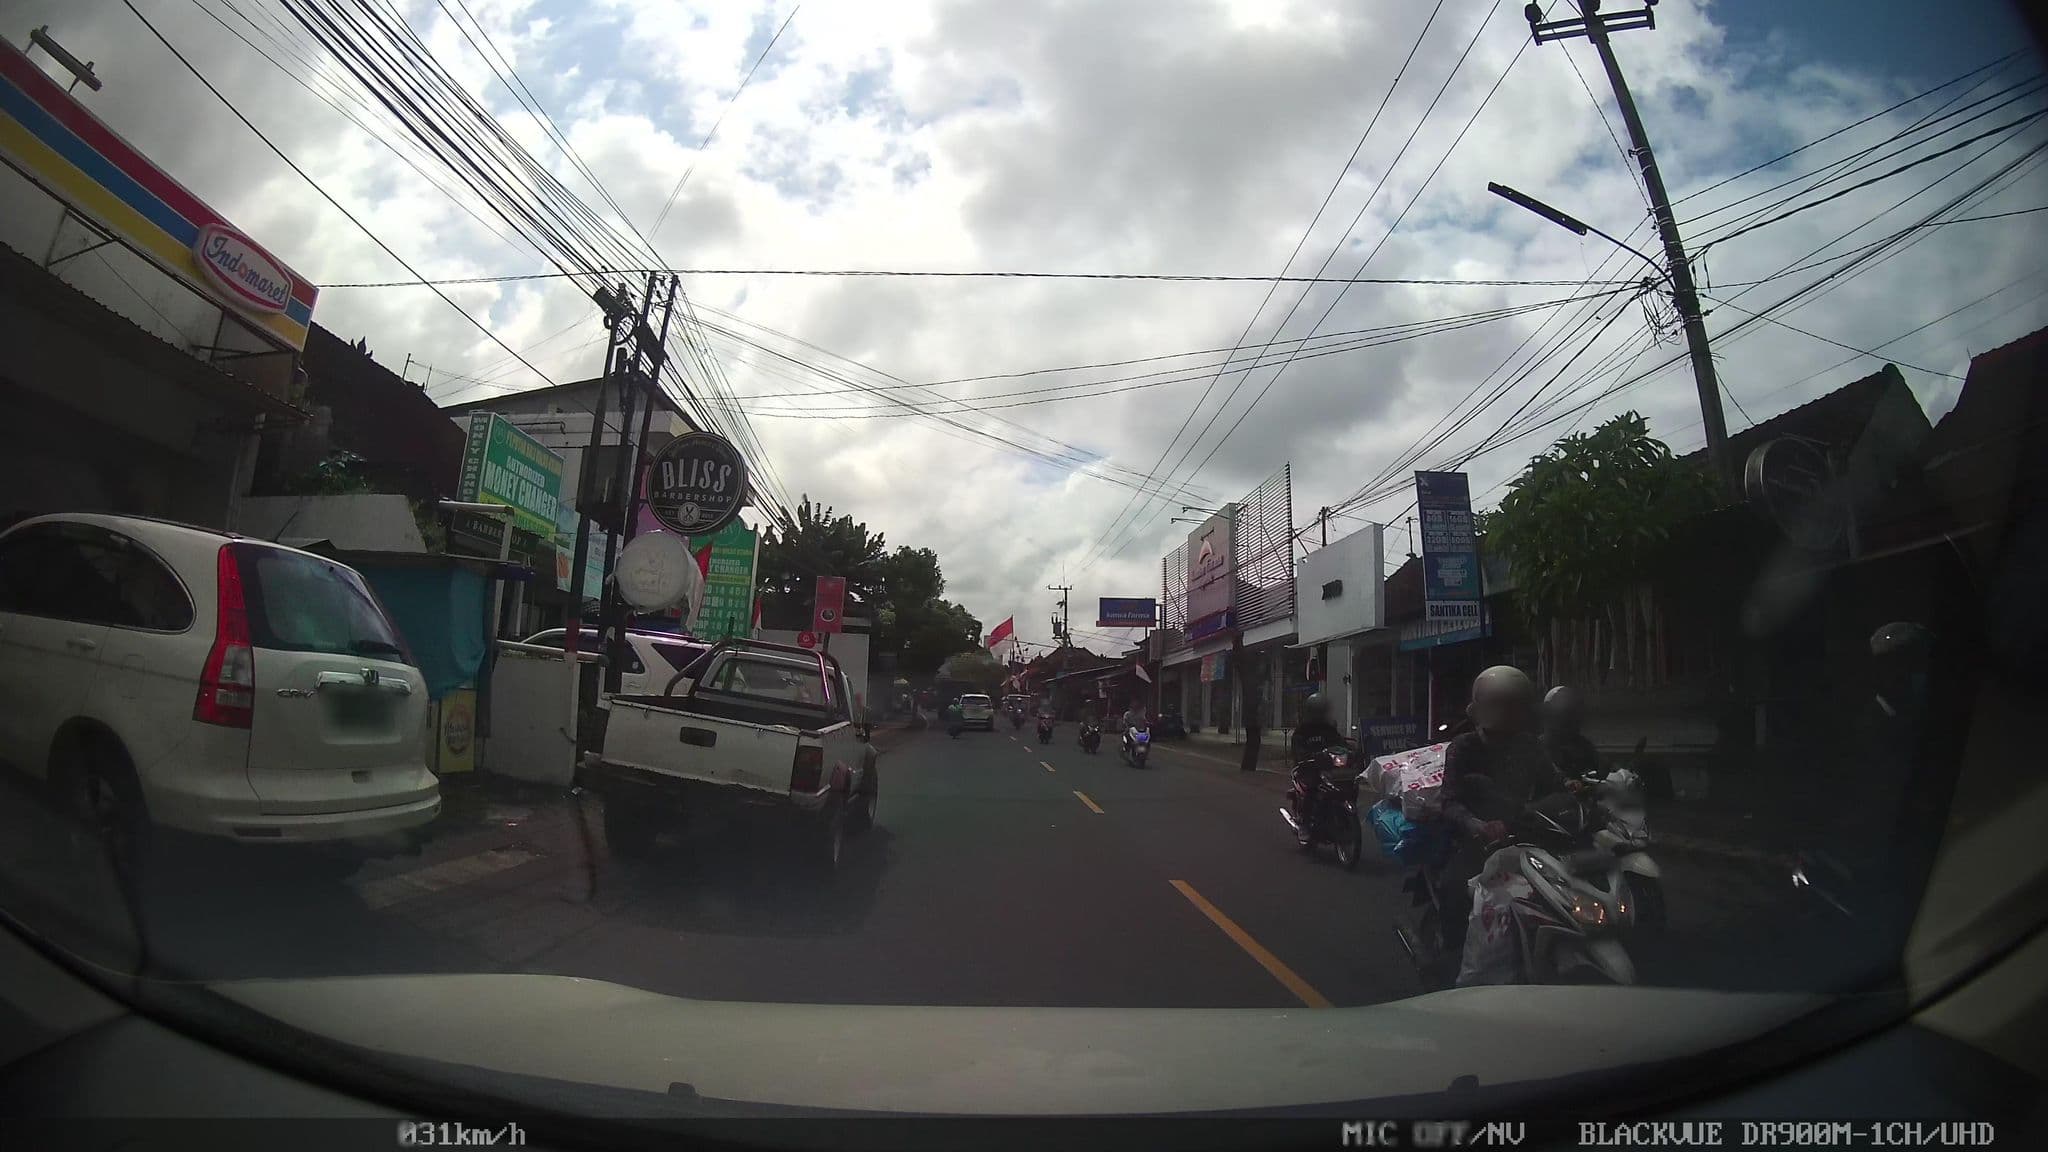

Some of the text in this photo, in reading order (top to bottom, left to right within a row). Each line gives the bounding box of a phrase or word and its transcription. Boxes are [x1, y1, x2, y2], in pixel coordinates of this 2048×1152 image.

[207, 236, 288, 304] Indomaret
[483, 460, 558, 523] MONEY CHANGER
[662, 458, 732, 493] BLISS
[653, 491, 732, 503] BARBERSHOP
[1430, 604, 1478, 617] SANTIKA CELL
